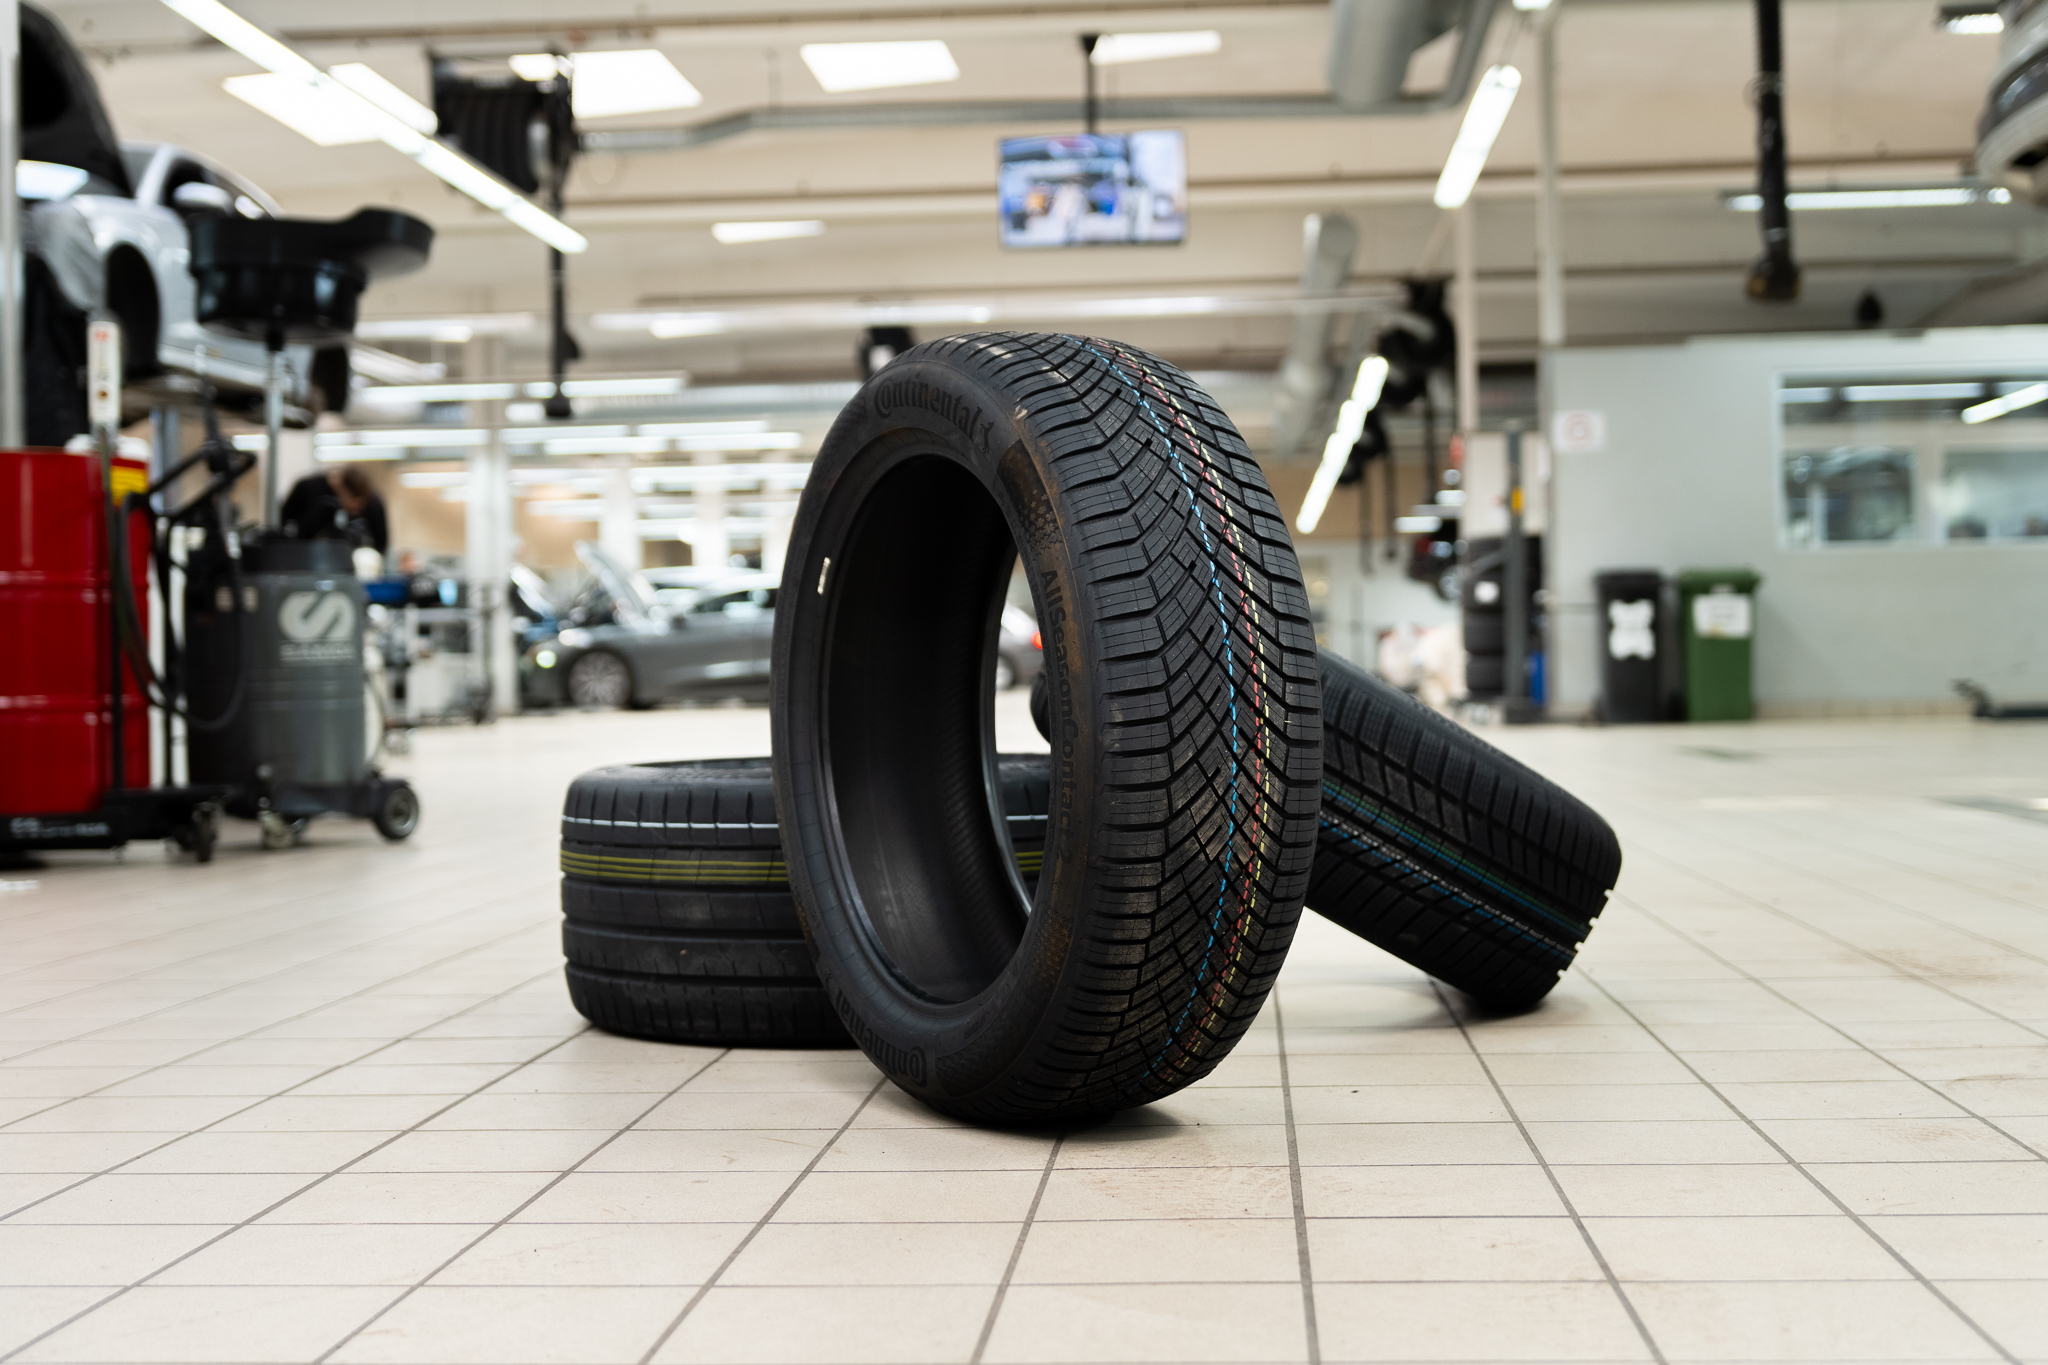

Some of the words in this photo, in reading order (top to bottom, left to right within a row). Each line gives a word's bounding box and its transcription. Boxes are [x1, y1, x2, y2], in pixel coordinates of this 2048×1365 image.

[874, 371, 983, 441] Continental
[1041, 571, 1079, 838] AllSeasonContact
[836, 987, 927, 1087] Continental
